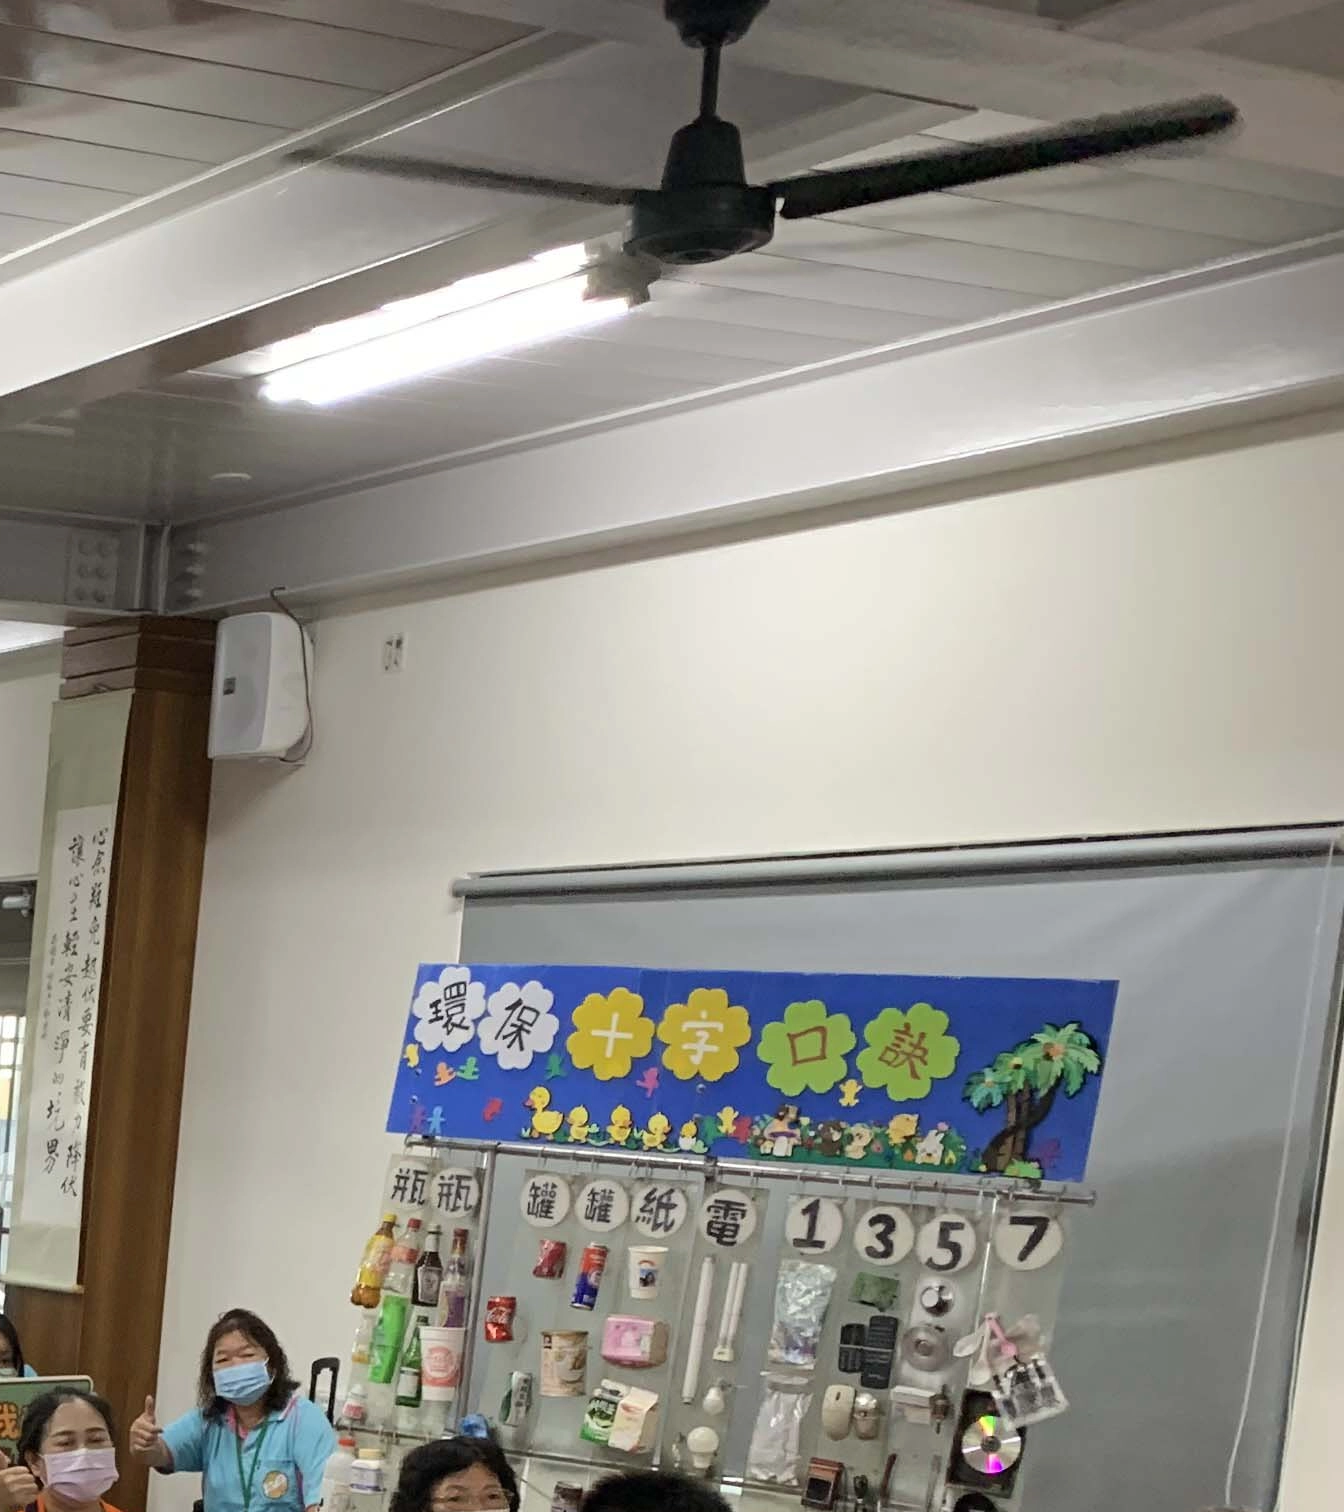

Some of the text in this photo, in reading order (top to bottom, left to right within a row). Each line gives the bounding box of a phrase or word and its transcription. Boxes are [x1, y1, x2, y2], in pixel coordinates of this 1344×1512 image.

[428, 982, 930, 1080] 環保十字口訣
[634, 1187, 678, 1232] 紙
[706, 1201, 749, 1247] 電
[795, 1200, 827, 1250] 1
[867, 1214, 896, 1260] 3
[927, 1222, 964, 1271] 5
[1008, 1216, 1050, 1263] 7
